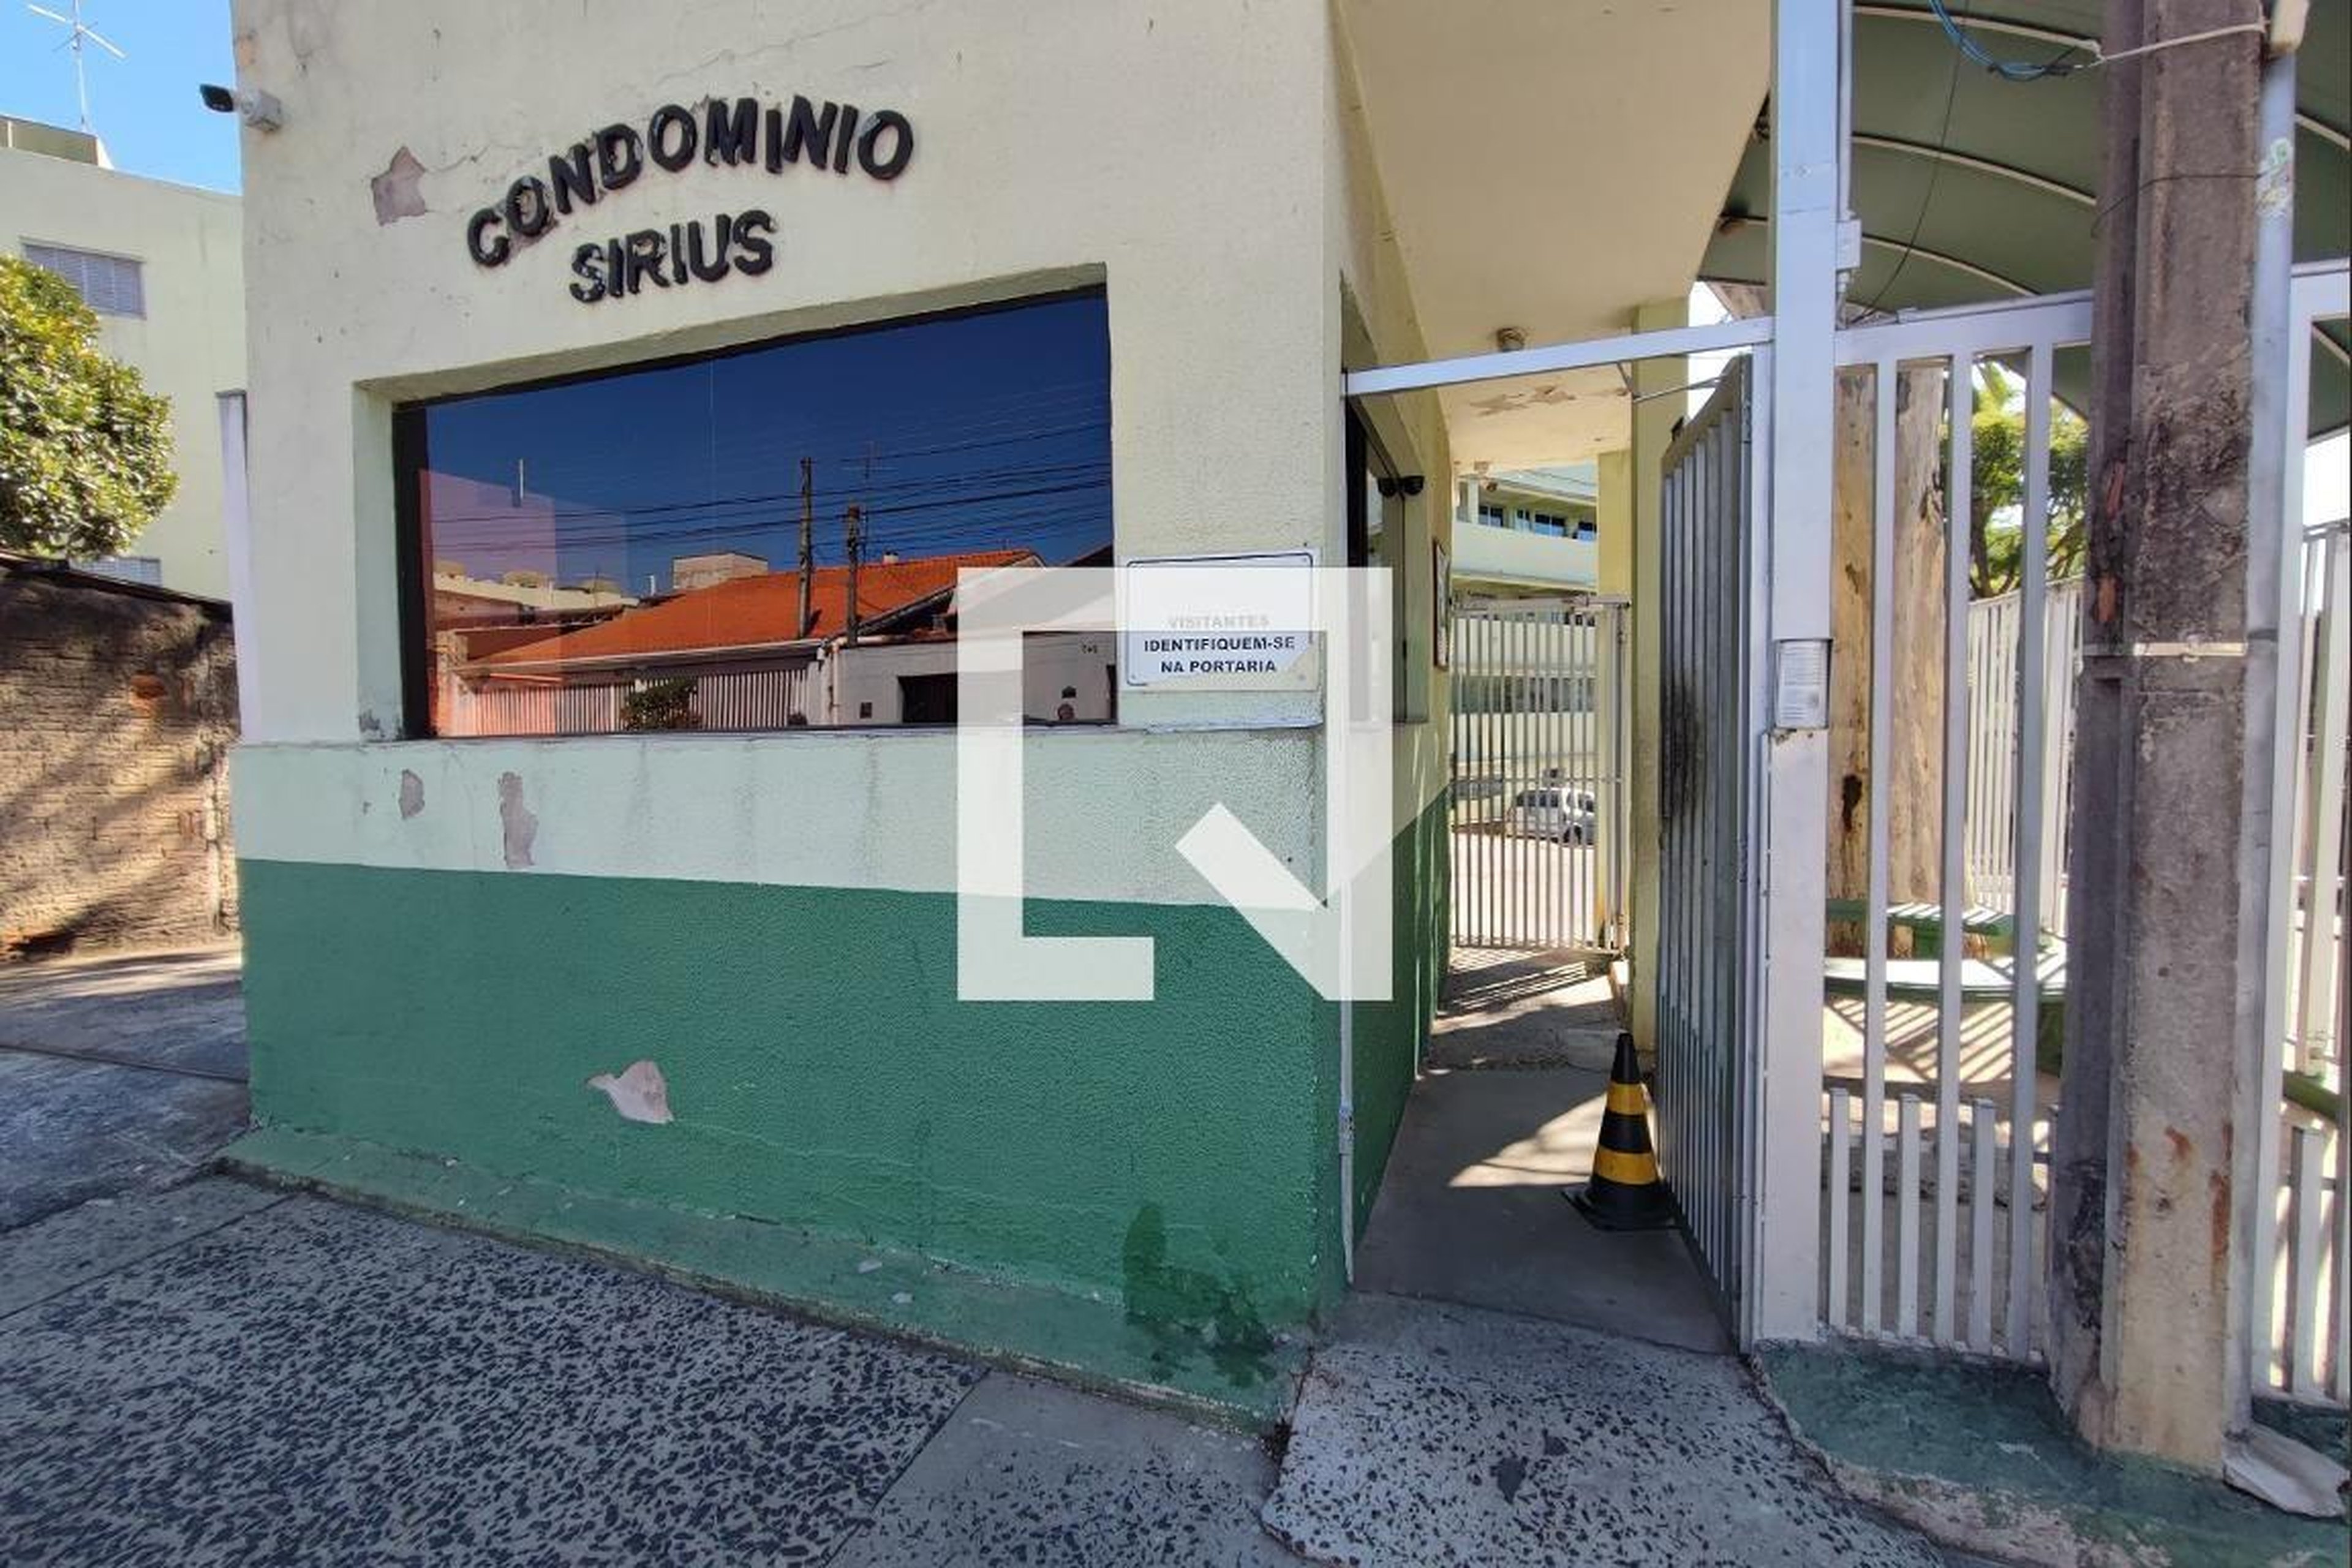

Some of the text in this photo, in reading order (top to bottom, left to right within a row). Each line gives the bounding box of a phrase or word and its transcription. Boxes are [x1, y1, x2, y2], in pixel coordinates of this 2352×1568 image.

[467, 94, 914, 268] CONDOMINIO
[569, 209, 776, 304] SIRIUS
[1144, 636, 1295, 653] IDENTIFIQUEM-SE
[1161, 659, 1277, 674] NA PORTARIA
